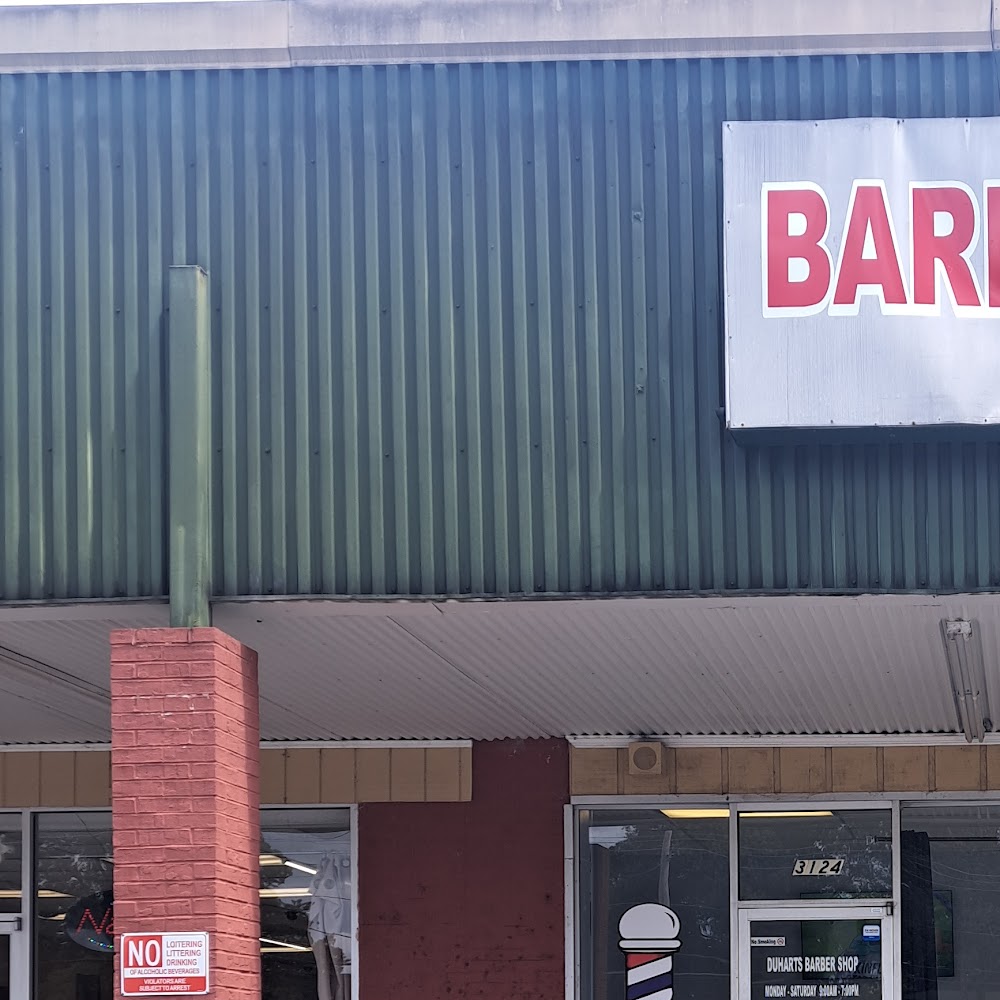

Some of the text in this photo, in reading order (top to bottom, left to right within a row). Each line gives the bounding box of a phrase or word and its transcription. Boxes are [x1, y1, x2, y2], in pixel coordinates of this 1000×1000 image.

[795, 860, 842, 874] 3124
[166, 941, 203, 949] LOITERING
[128, 940, 161, 967] NO
[166, 949, 202, 957] LITTERING
[166, 958, 198, 966] DRINKING
[766, 957, 803, 973] DUHARTS
[804, 957, 837, 972] BARBER
[837, 956, 859, 972] SHOP
[764, 985, 786, 998] MONDAY
[790, 985, 817, 997] SATURDAY
